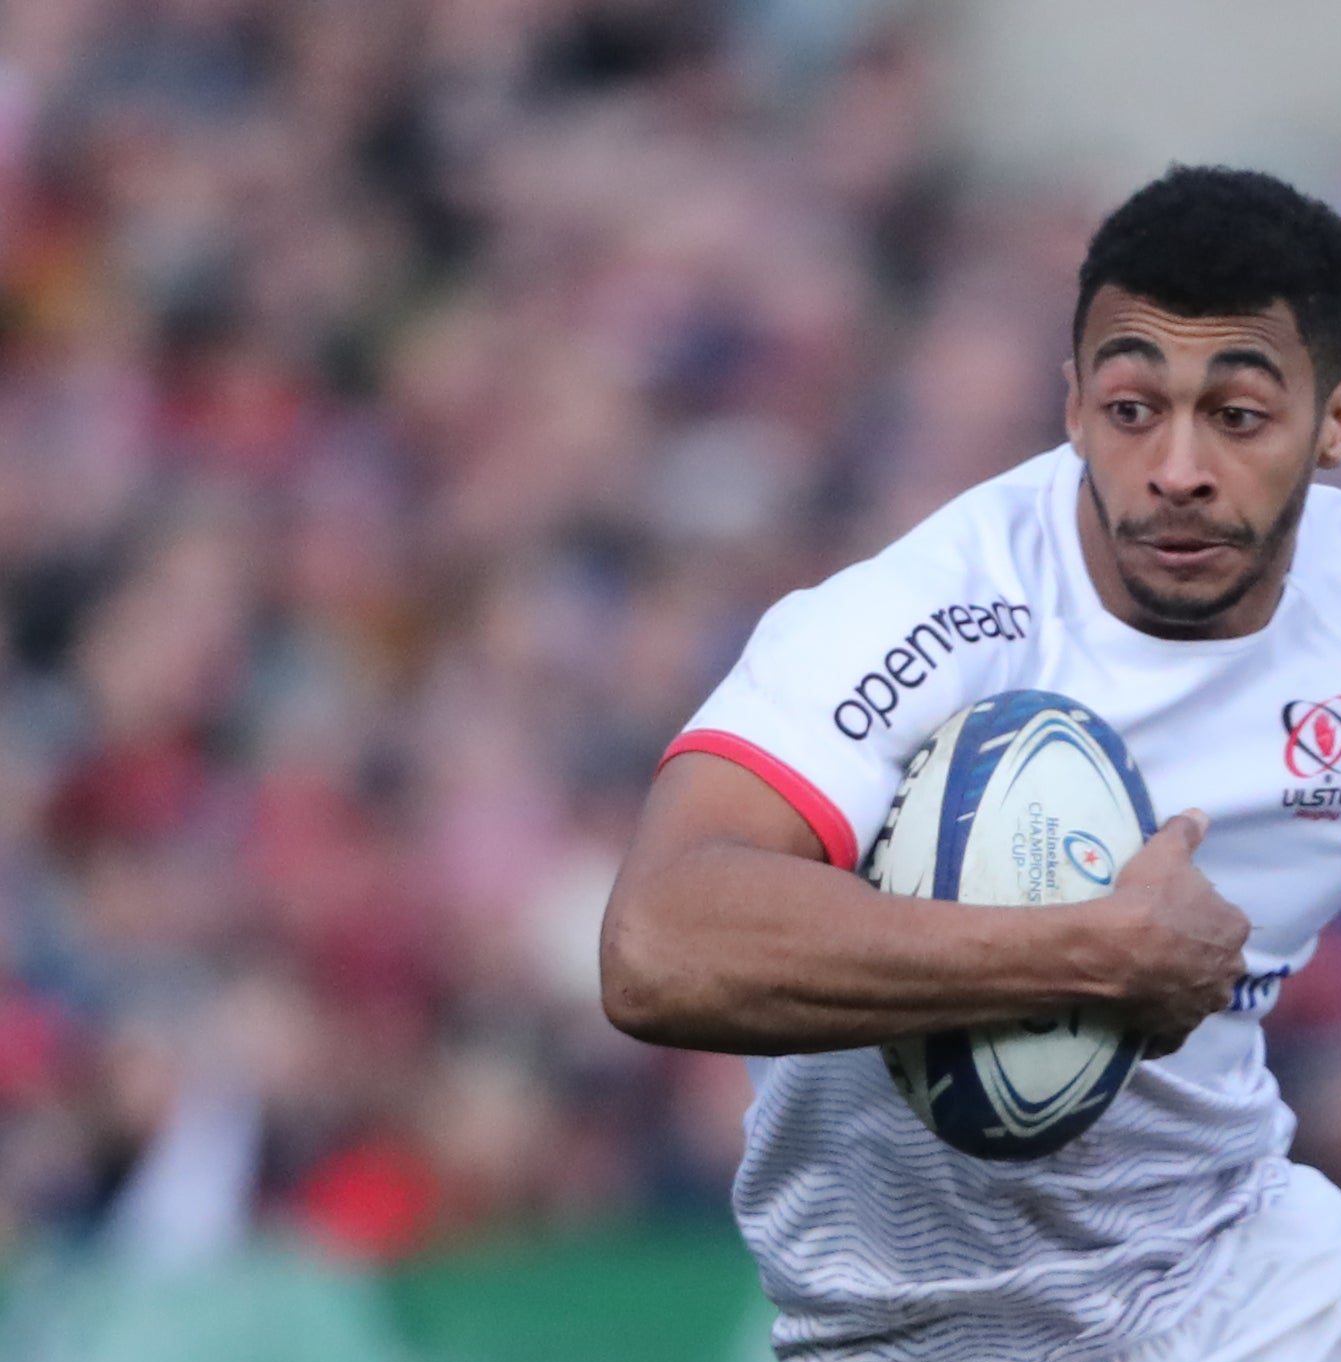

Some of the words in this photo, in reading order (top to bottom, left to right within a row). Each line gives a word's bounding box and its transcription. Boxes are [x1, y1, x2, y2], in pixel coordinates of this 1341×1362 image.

[834, 596, 1032, 740] openreach
[1012, 832, 1025, 868] CUP
[1029, 802, 1042, 902] CHAMPIONS
[1046, 817, 1059, 888] Heineken
